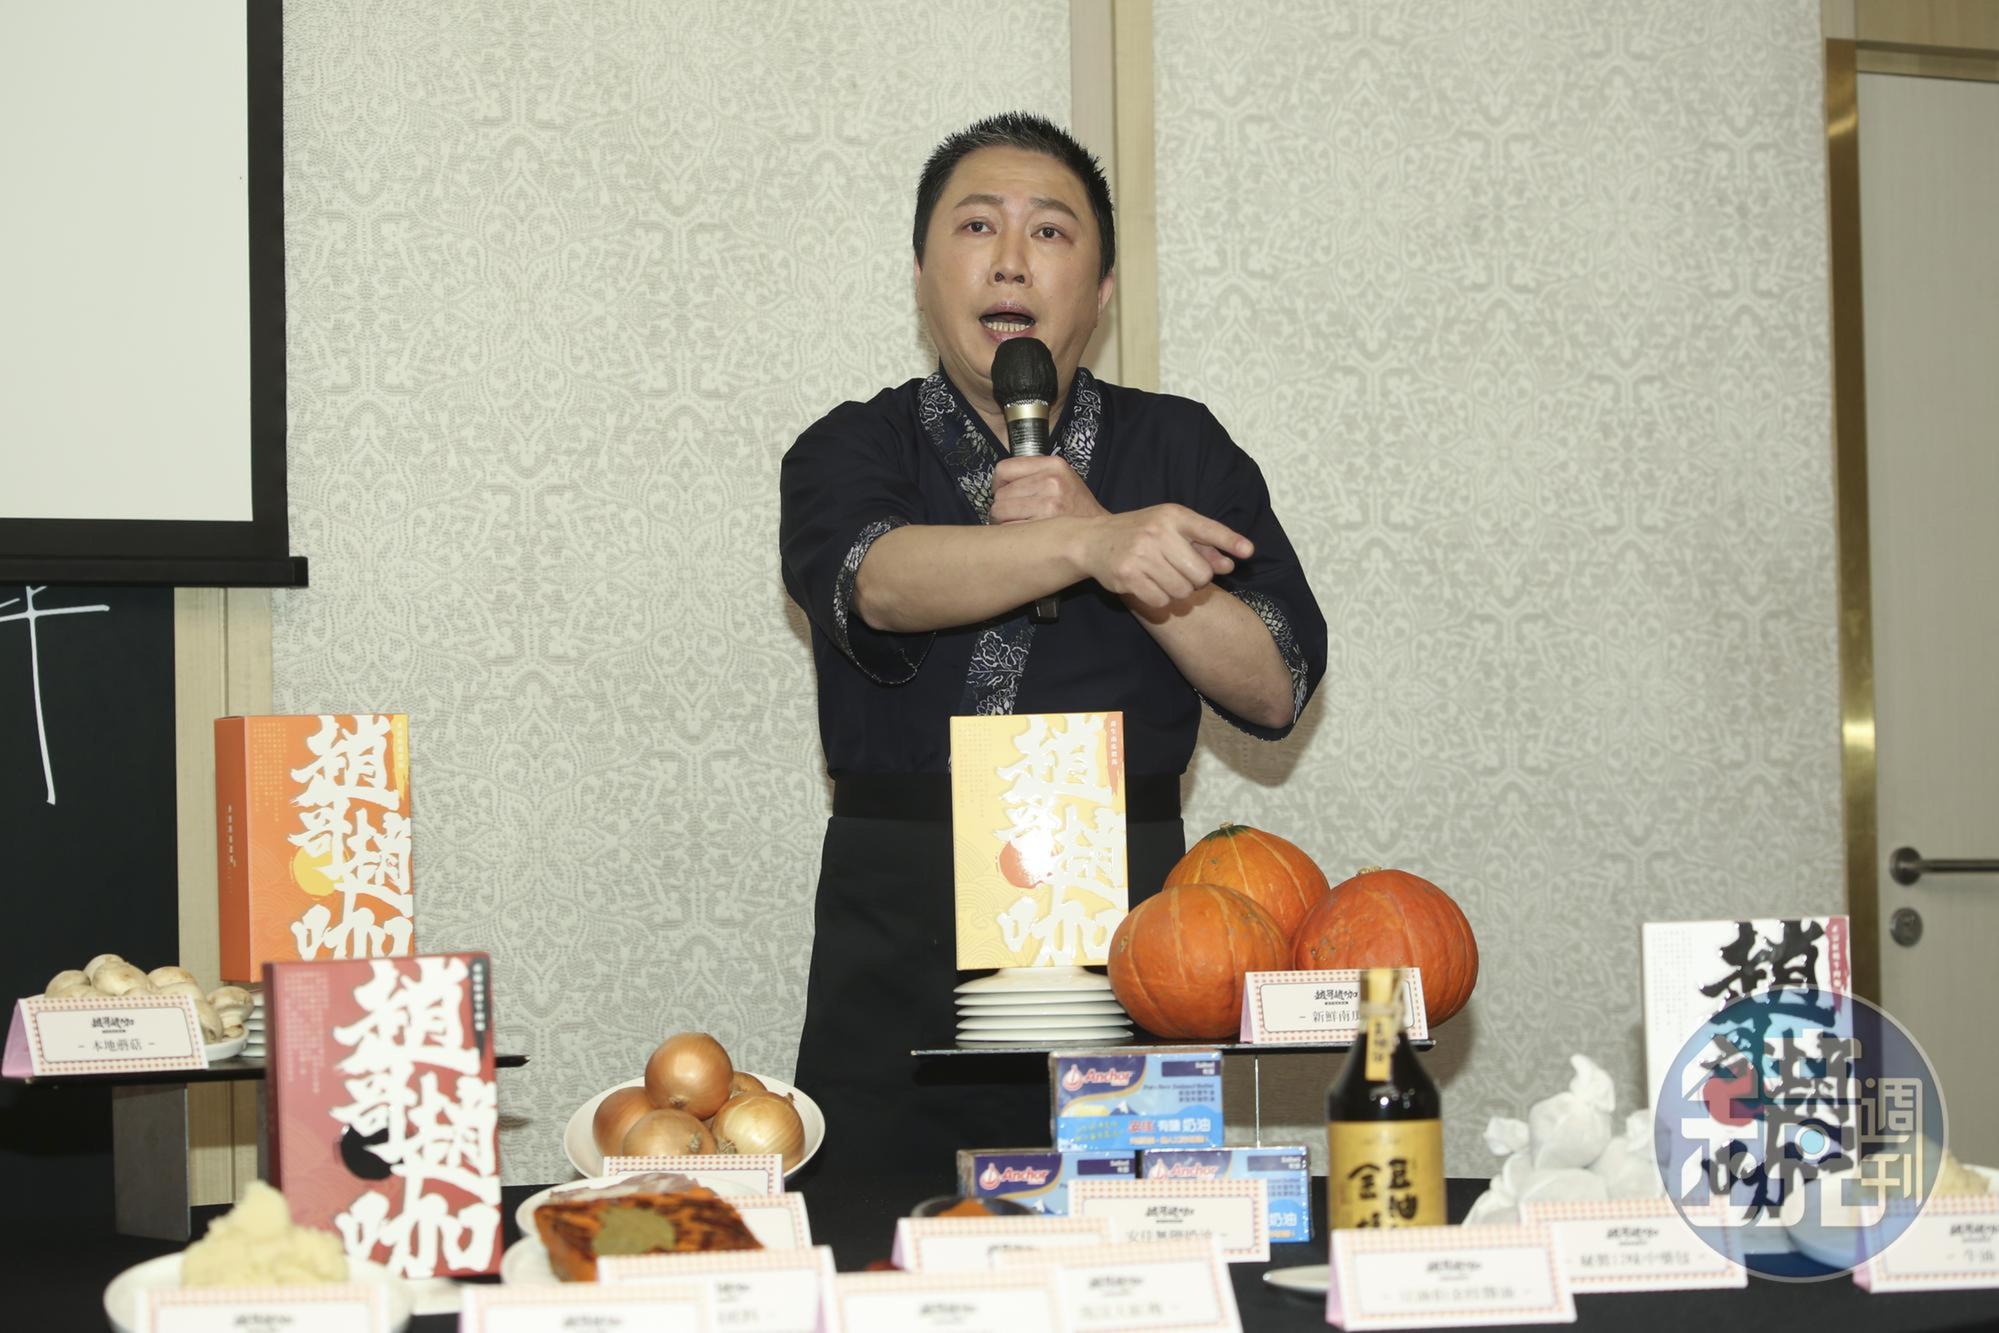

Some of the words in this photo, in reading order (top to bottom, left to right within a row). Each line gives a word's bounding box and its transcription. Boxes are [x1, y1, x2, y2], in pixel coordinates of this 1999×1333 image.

[1083, 1066, 1133, 1084] Anchor
[1182, 1117, 1211, 1133] 奶油
[1002, 1166, 1050, 1184] Anchor
[1169, 1162, 1219, 1178] Anchor
[1388, 1158, 1418, 1229] 豆油
